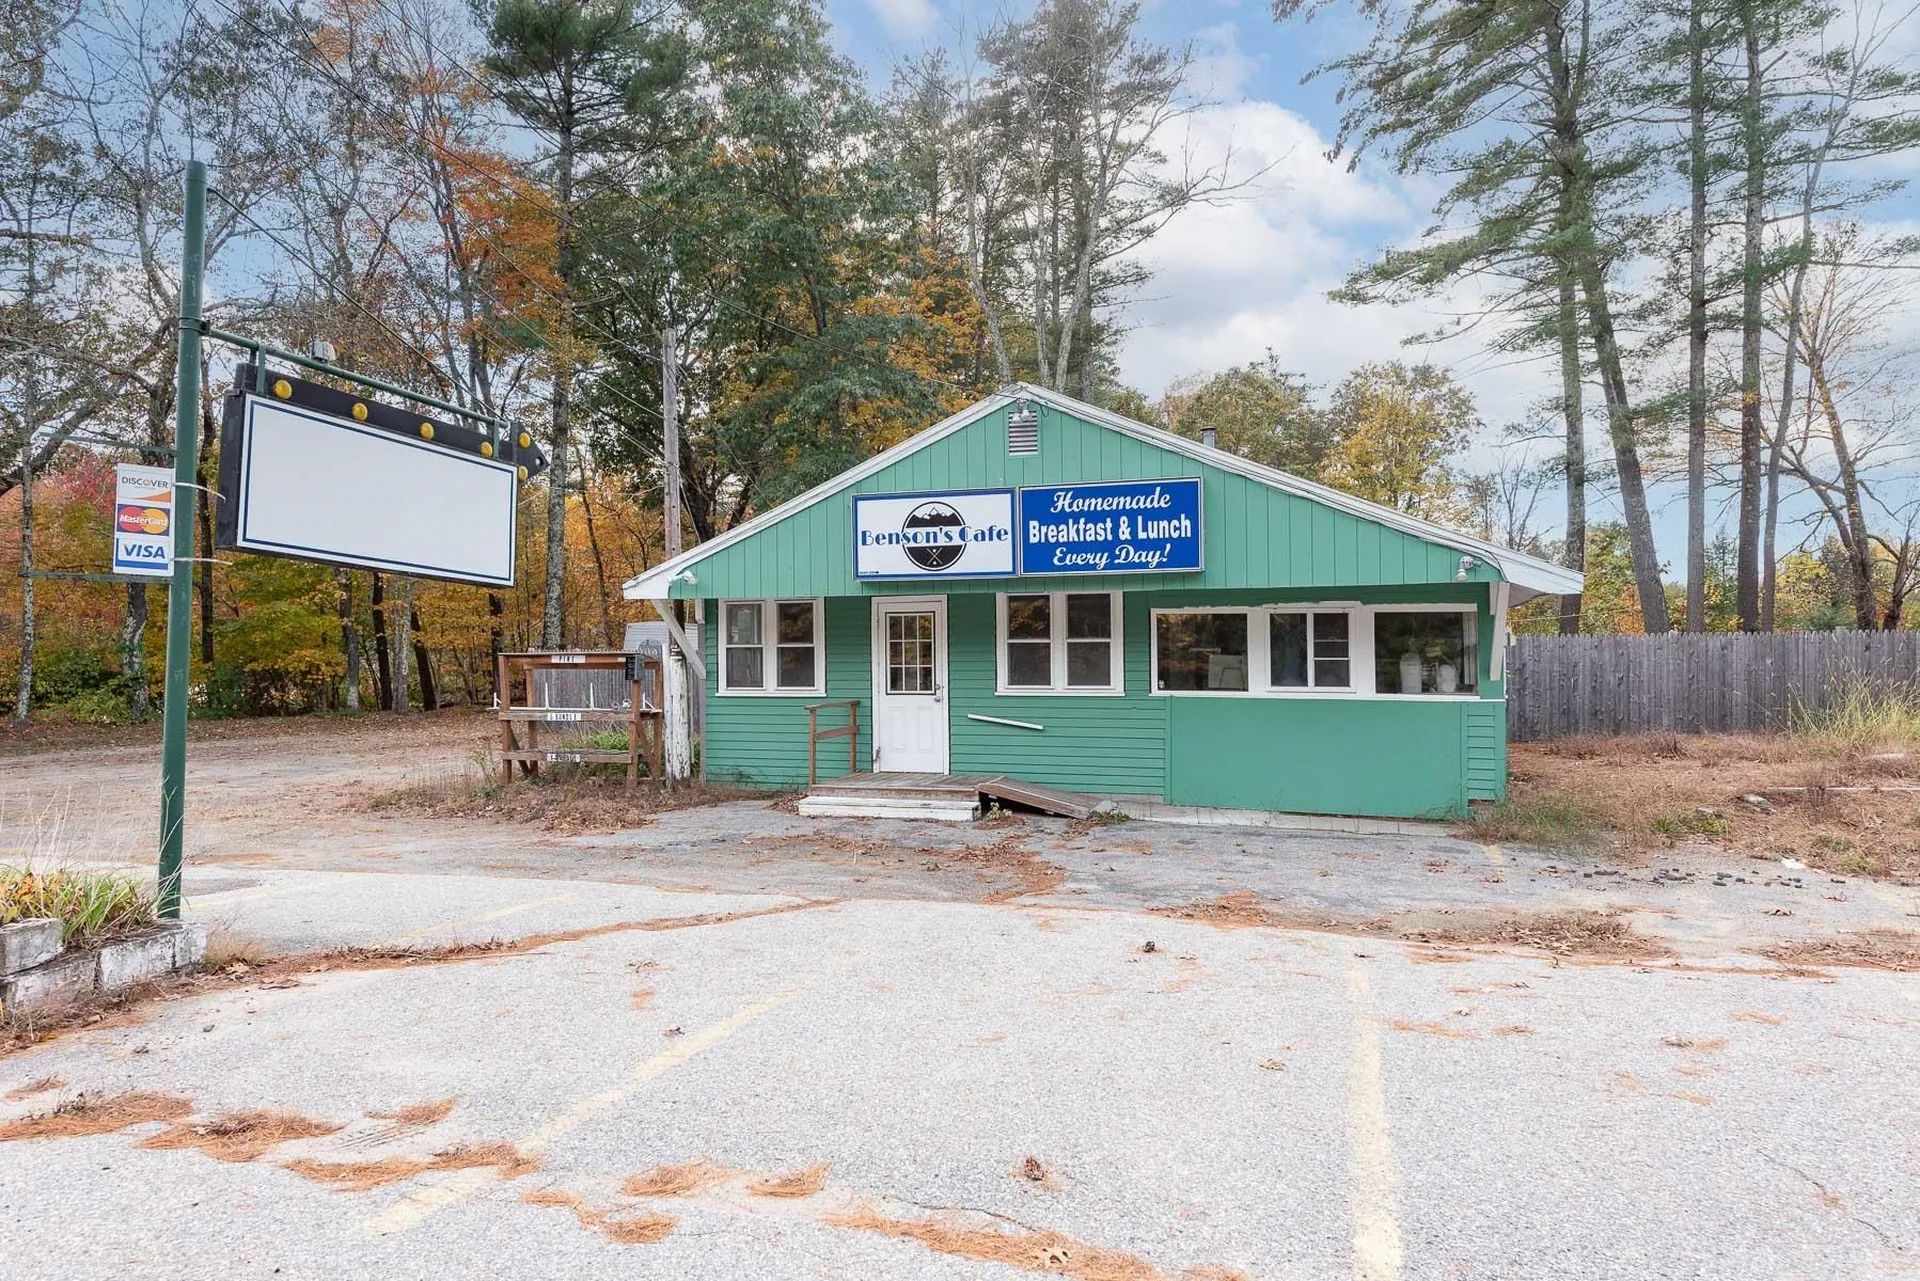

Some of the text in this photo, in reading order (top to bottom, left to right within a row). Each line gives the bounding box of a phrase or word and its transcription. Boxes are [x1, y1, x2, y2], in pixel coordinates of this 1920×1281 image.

[121, 476, 169, 489] DISCOVER
[1050, 486, 1172, 513] Homemade
[861, 524, 1009, 547] Benson's Cafe
[1028, 513, 1192, 544] Breakfast & Lunch
[123, 543, 166, 559] VISA
[1052, 543, 1172, 570] Every Day!
